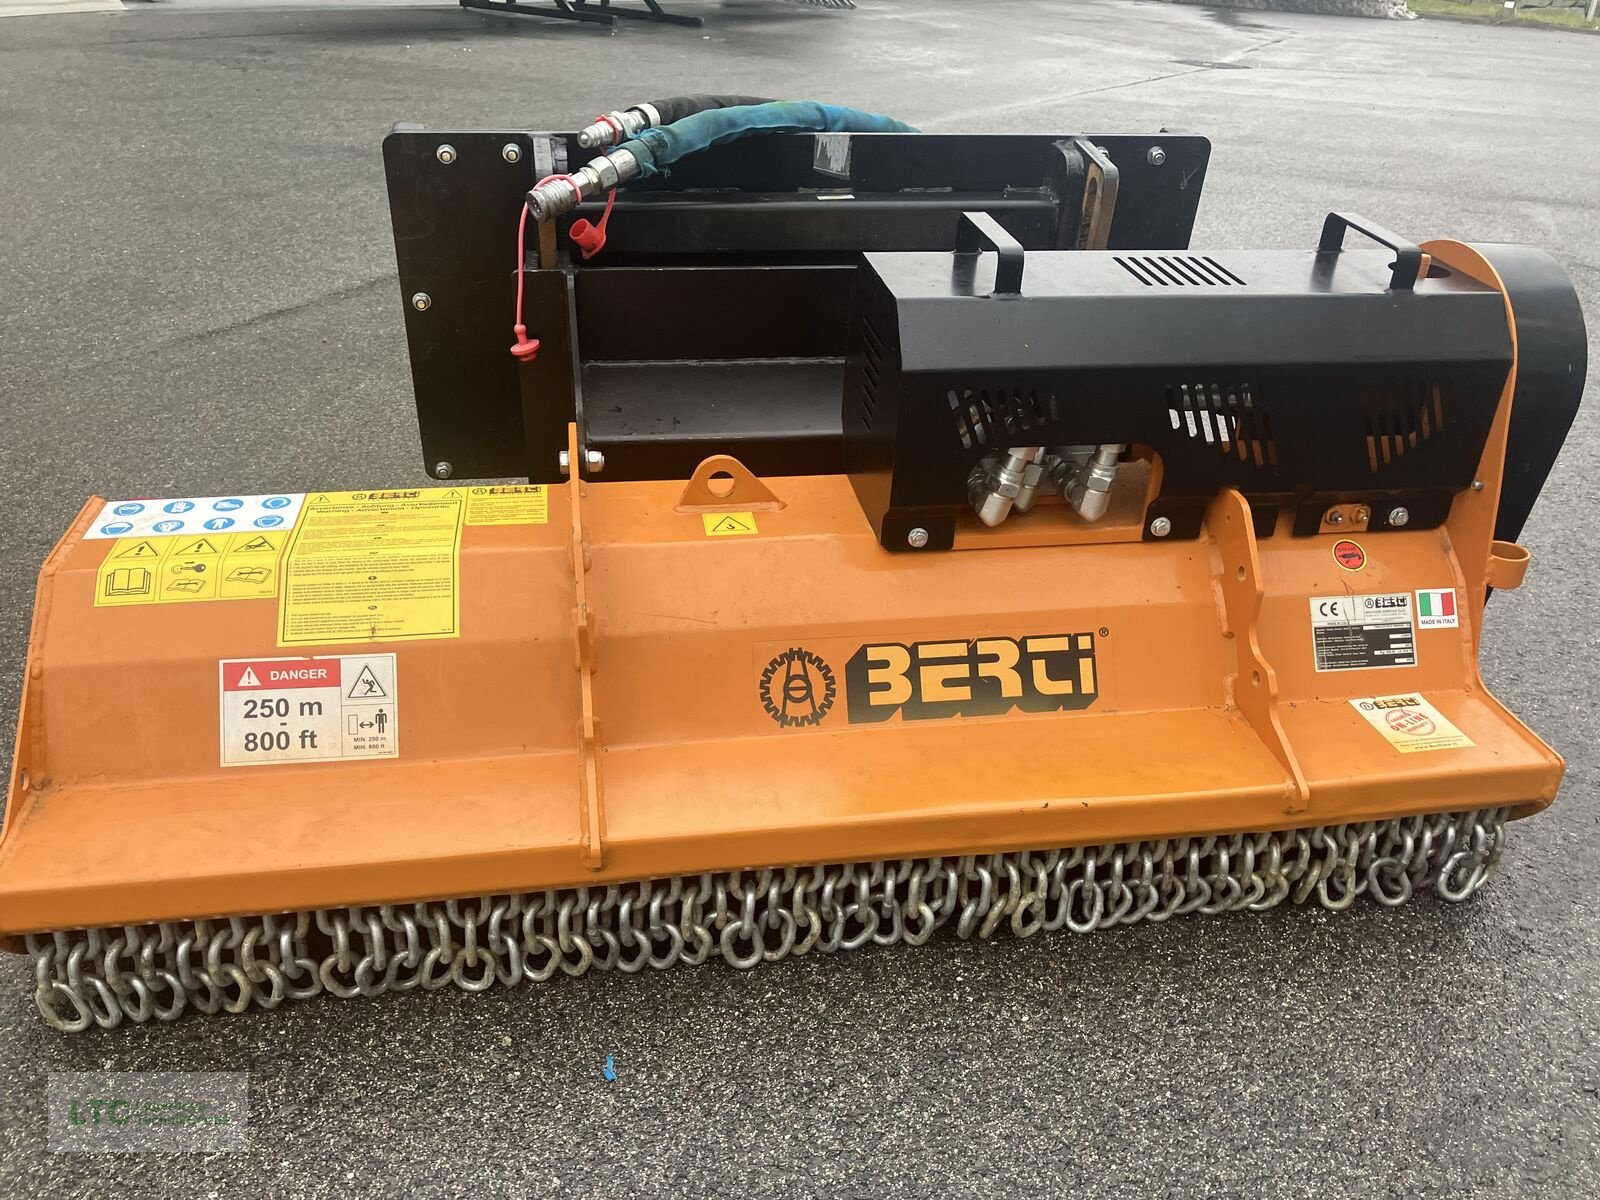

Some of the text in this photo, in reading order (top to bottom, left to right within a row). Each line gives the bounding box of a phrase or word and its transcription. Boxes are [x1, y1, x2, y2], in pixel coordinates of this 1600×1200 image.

[270, 668, 328, 681] DANGER
[243, 698, 323, 719] 250 m
[1390, 713, 1428, 731] ON-LINE
[243, 730, 318, 752] 800 ft
